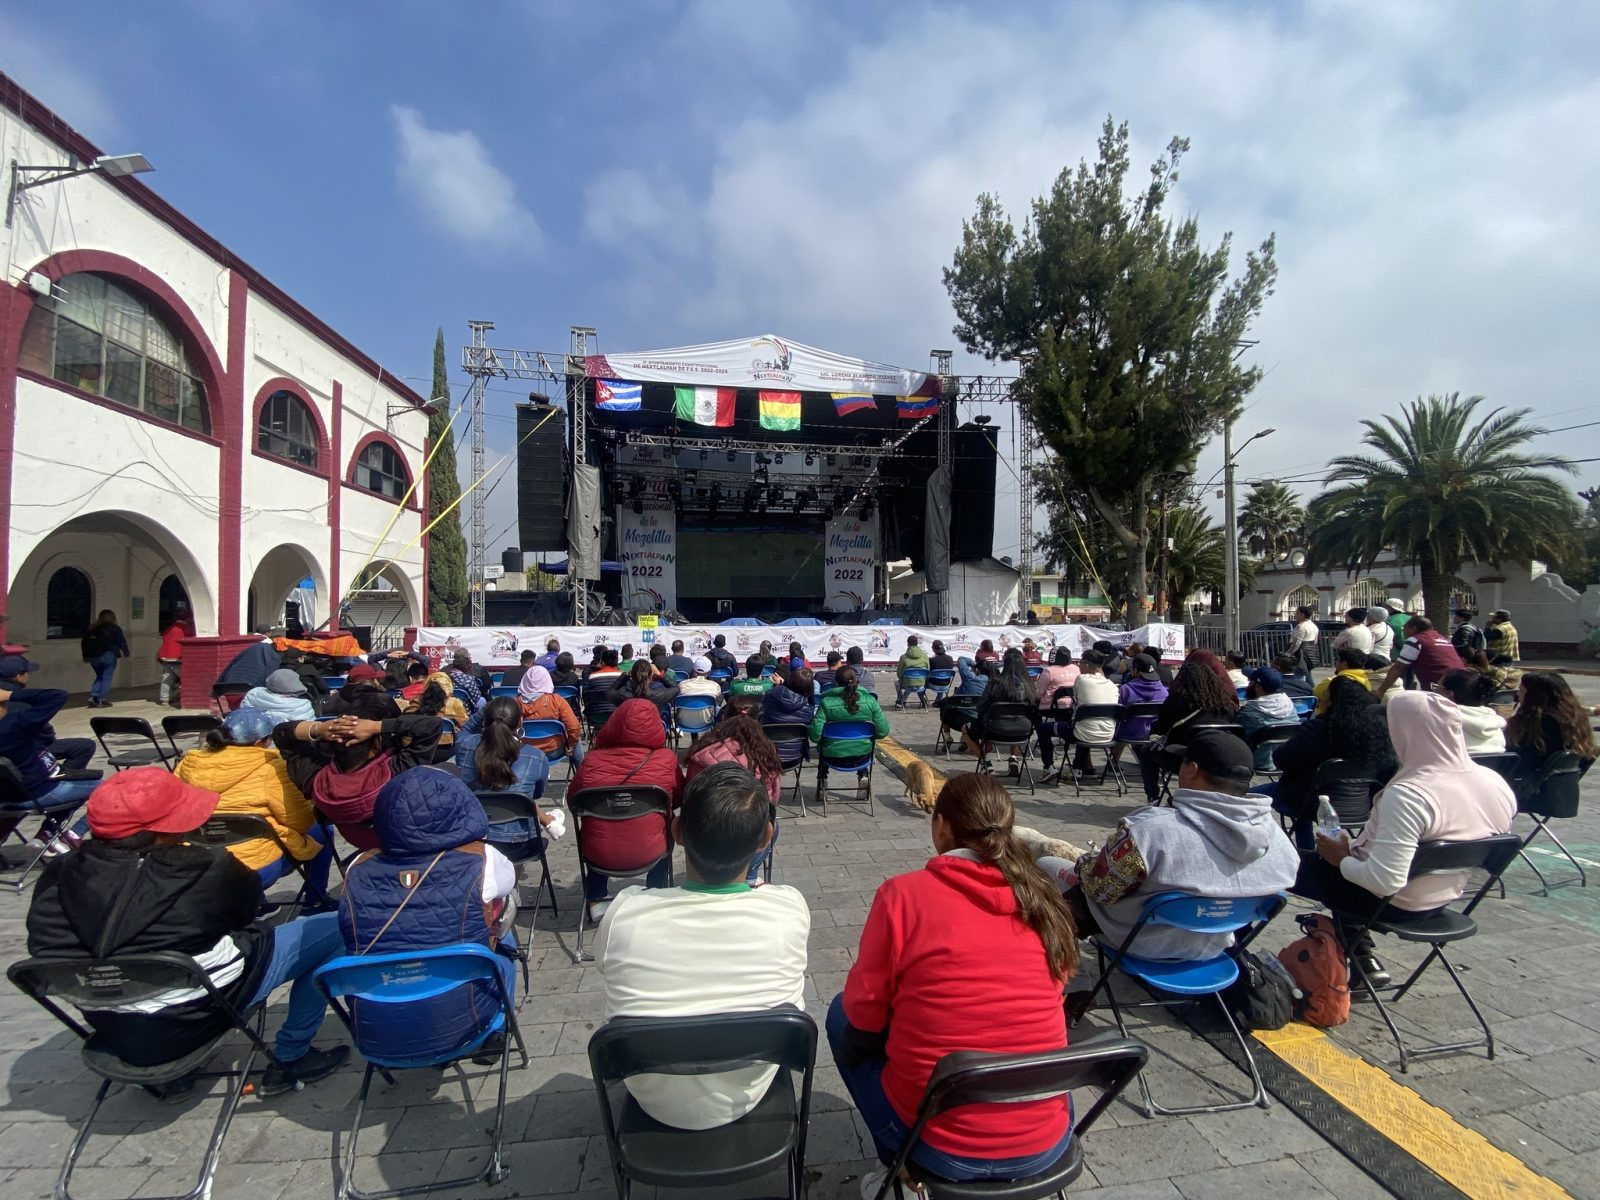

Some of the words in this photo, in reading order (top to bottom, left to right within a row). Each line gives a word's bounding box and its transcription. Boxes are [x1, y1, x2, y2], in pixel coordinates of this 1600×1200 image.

[625, 528, 673, 548] Mezclilla
[830, 534, 873, 552] Mezclilla
[631, 566, 663, 577] 2022
[834, 569, 864, 580] 2022
